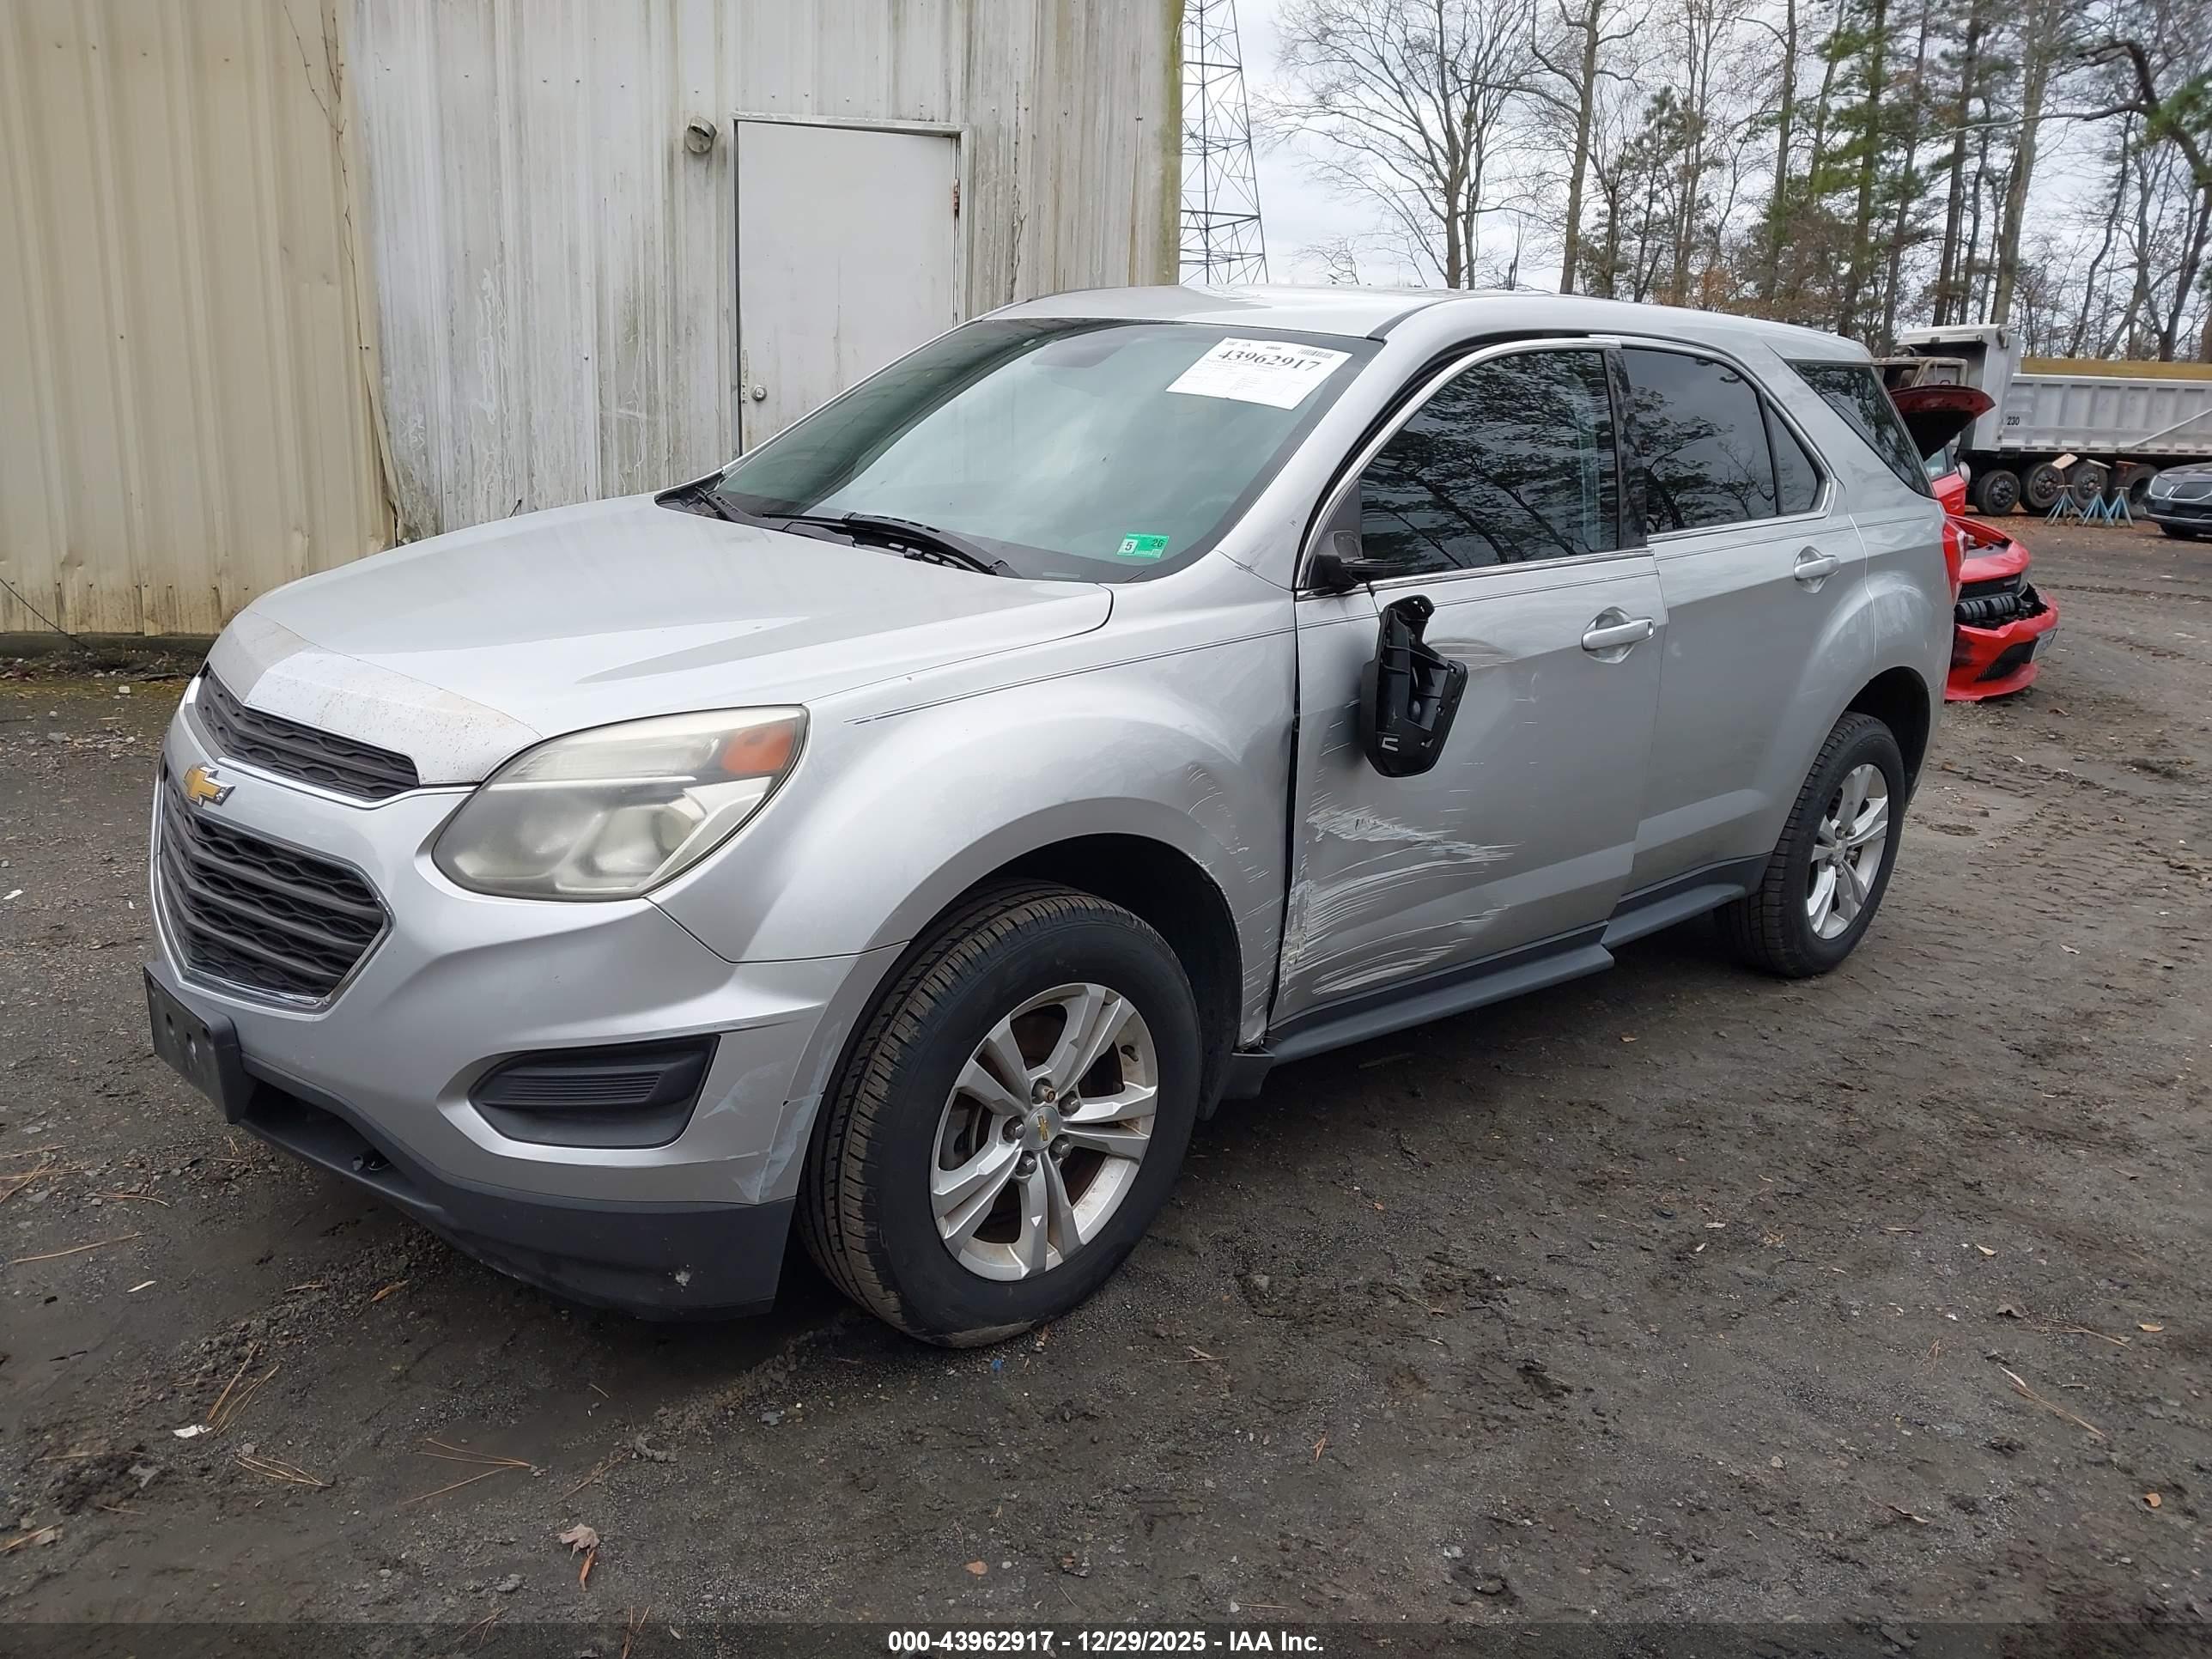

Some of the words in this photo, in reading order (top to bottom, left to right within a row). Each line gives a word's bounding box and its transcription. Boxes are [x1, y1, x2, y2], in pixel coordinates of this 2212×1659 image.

[1218, 349, 1322, 372] 43962917
[2006, 416, 2021, 426] 230
[1124, 541, 1134, 551] 5
[1151, 538, 1165, 548] 26
